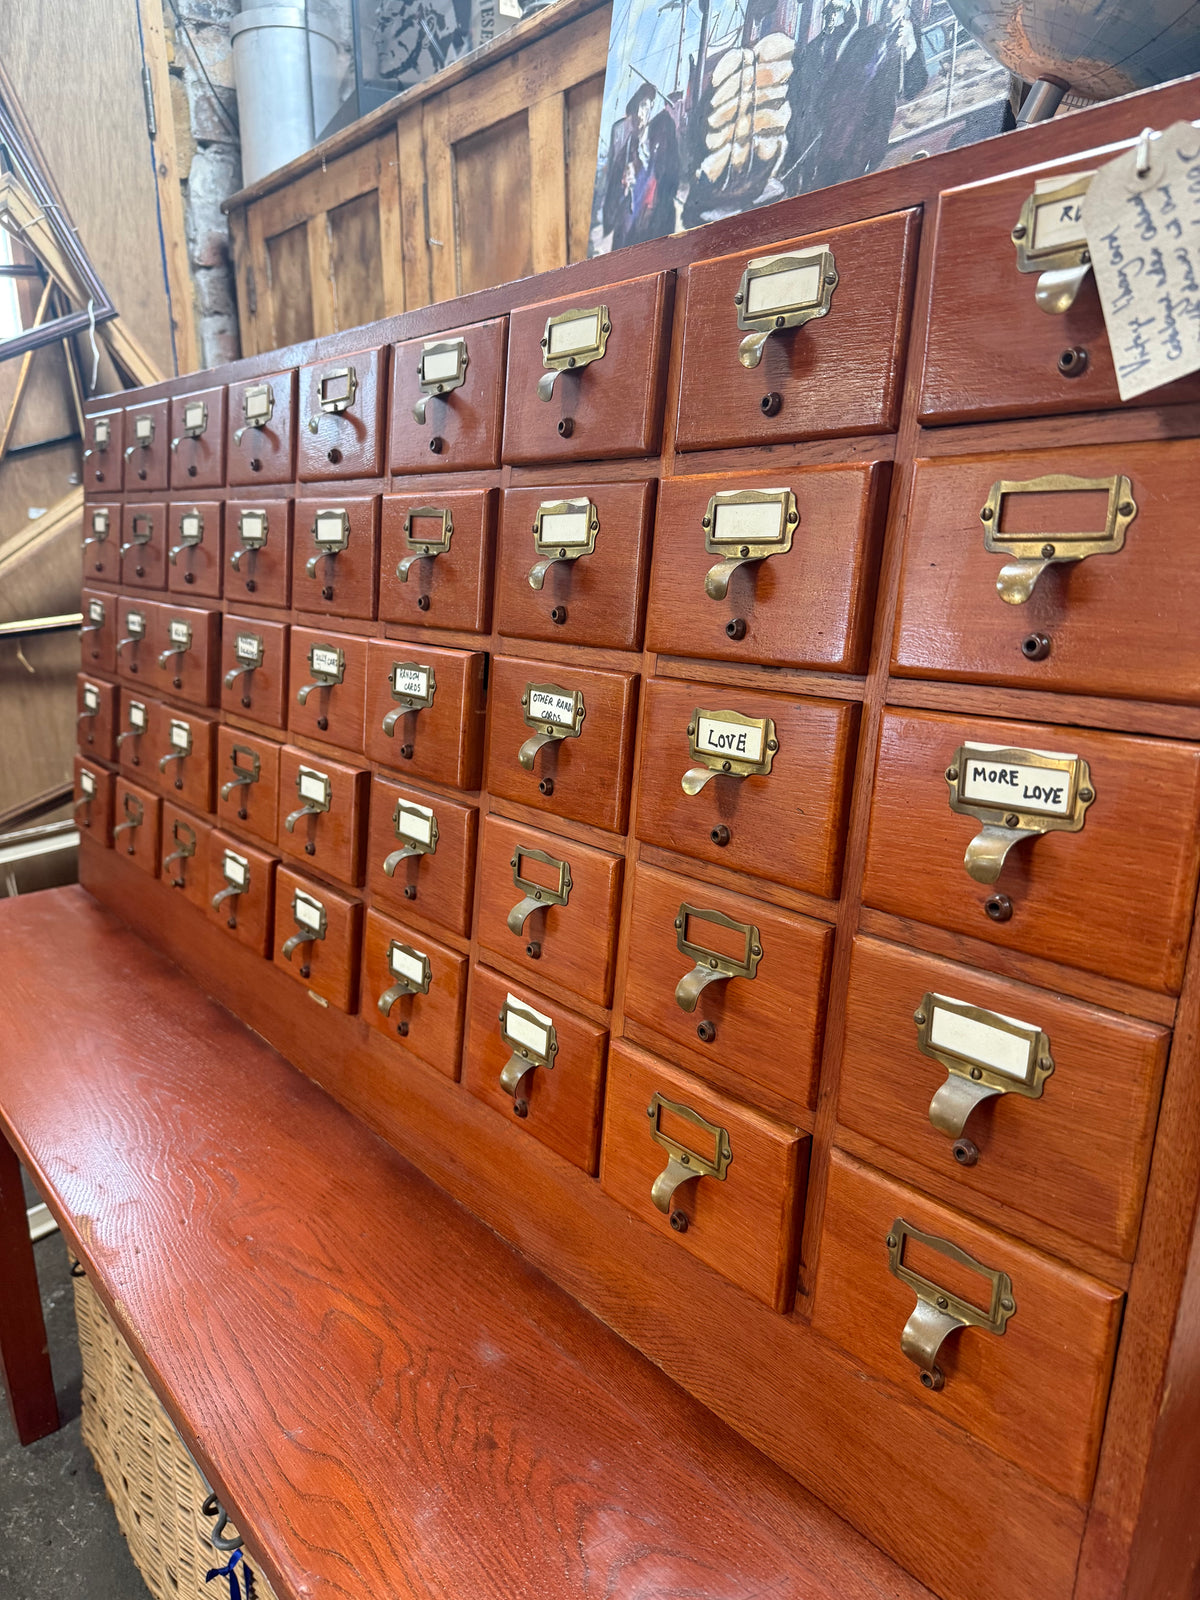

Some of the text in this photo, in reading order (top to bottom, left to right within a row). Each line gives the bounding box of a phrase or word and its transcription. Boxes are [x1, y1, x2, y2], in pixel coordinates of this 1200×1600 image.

[403, 682, 421, 693] CARDS
[532, 693, 554, 706] OTHER
[541, 710, 561, 722] CARDS
[707, 729, 748, 753] LOVE
[973, 767, 1064, 804] MORE LOVE
